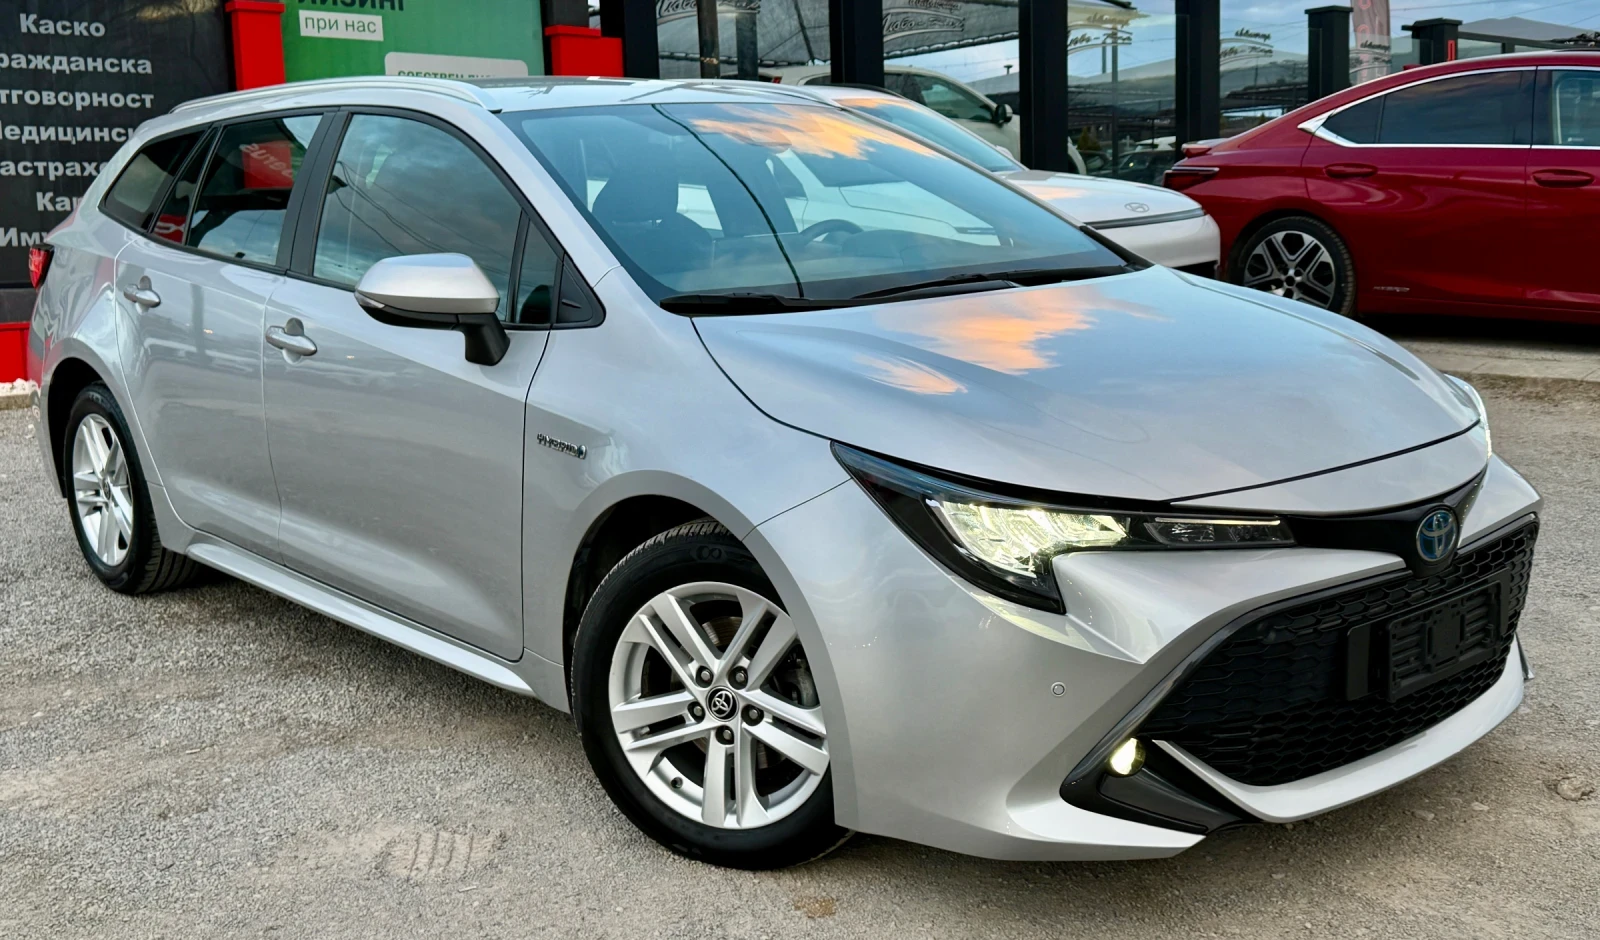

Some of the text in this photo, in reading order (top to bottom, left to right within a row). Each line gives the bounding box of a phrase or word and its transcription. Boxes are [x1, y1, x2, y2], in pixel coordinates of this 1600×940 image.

[19, 13, 106, 37] Каско
[304, 16, 377, 34] при нас
[0, 120, 135, 145] едицинс
[0, 160, 108, 181] астрах
